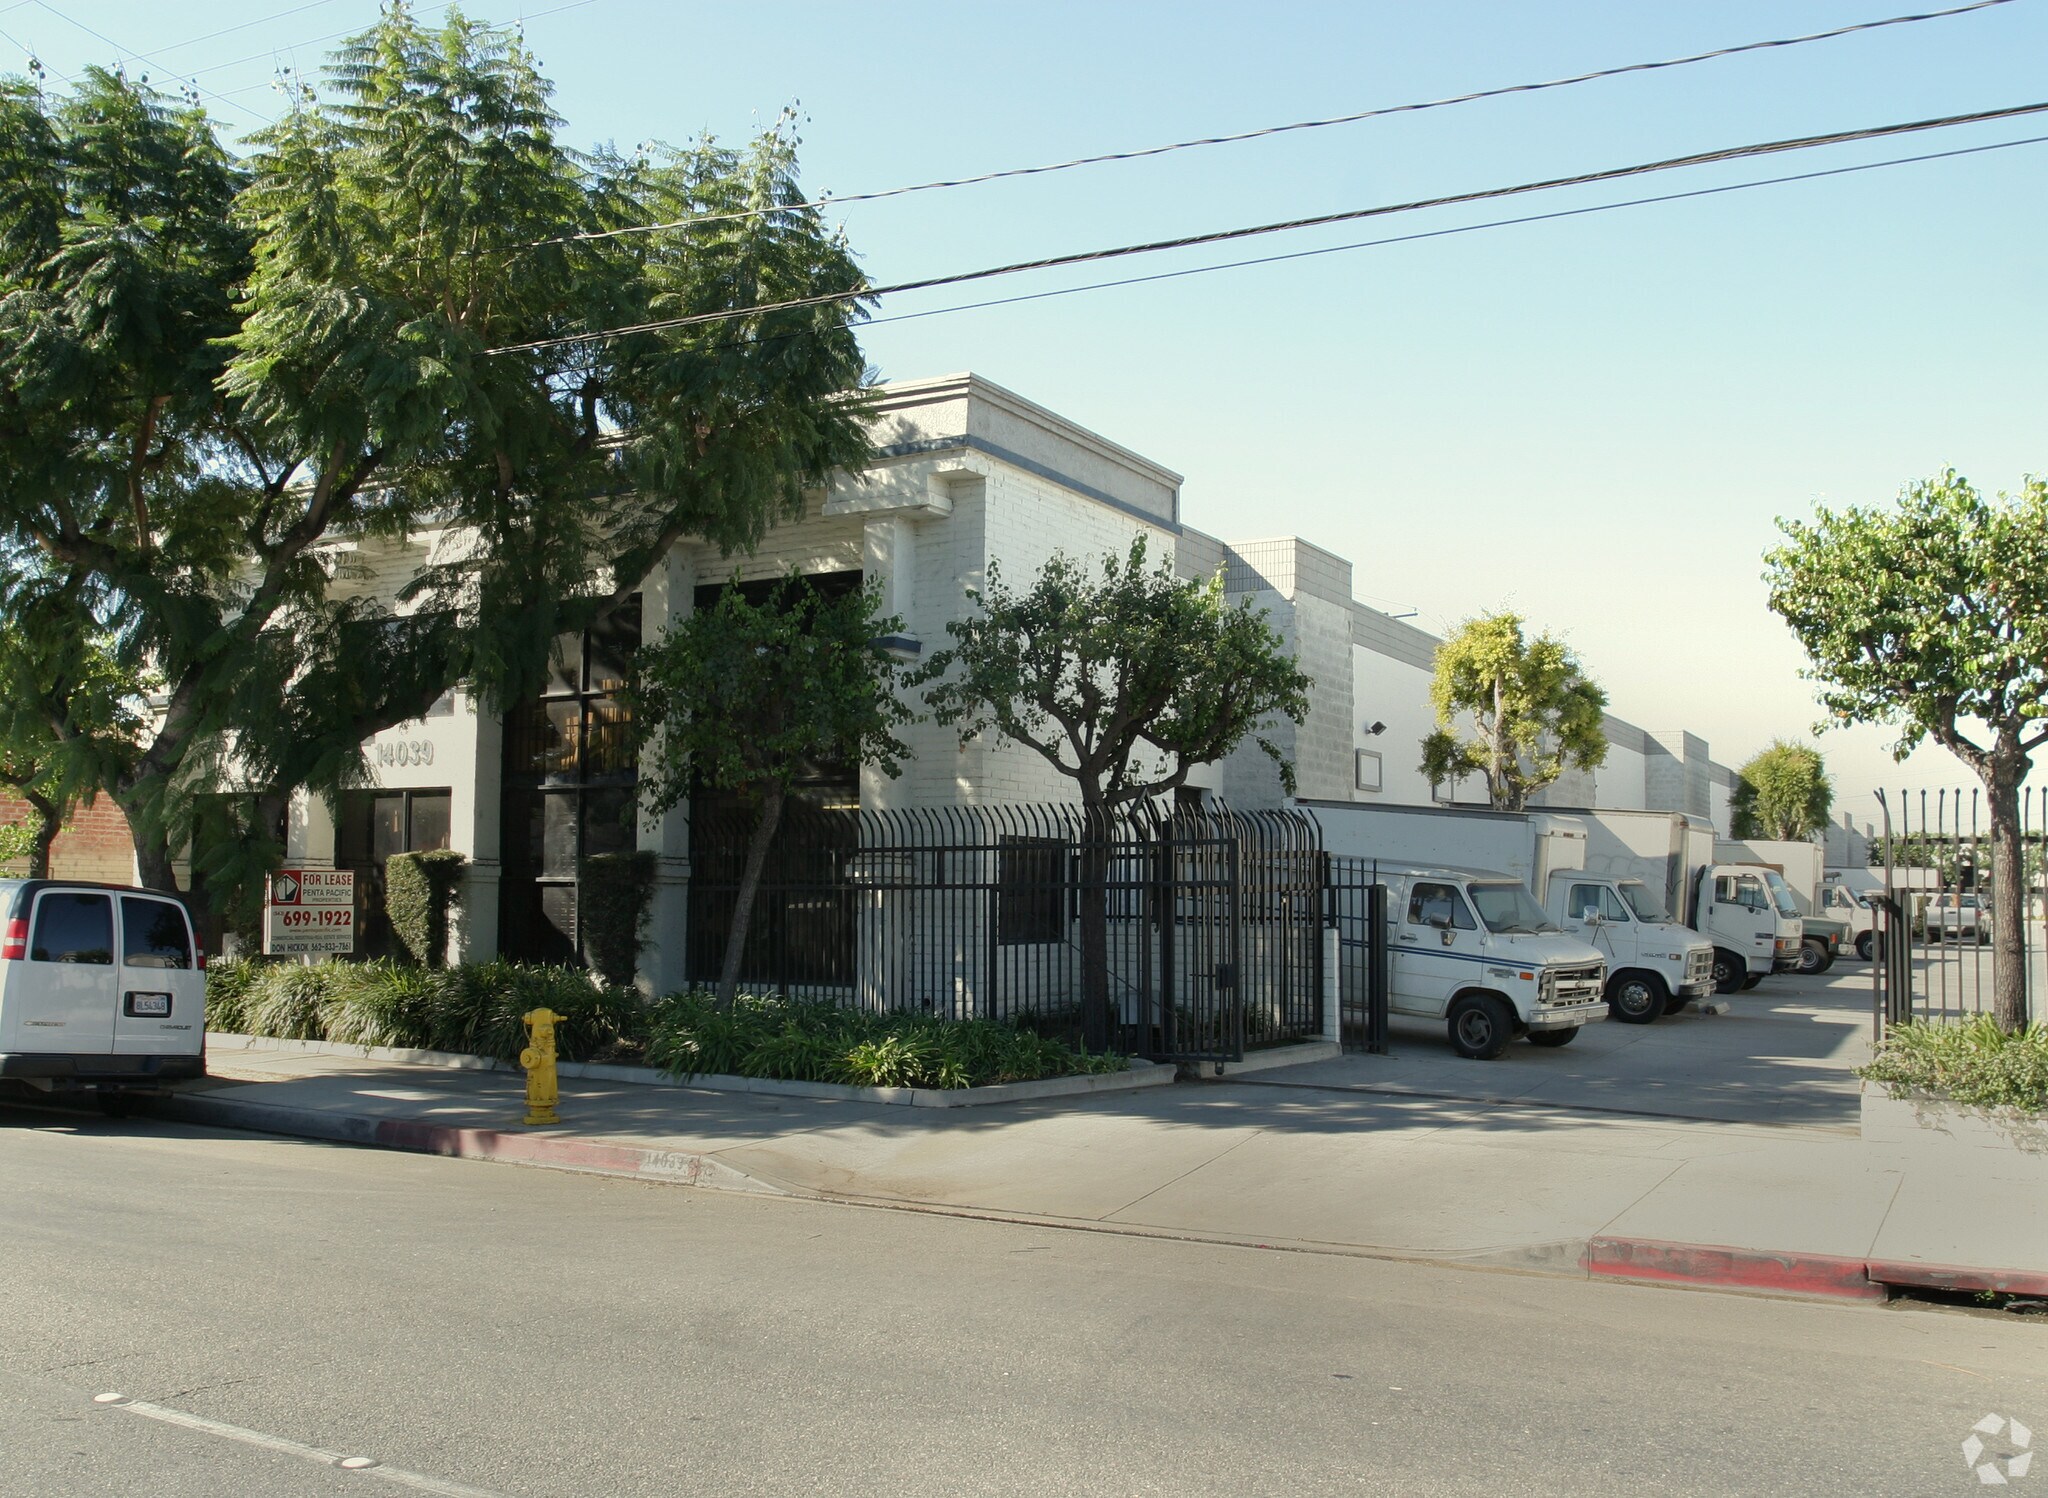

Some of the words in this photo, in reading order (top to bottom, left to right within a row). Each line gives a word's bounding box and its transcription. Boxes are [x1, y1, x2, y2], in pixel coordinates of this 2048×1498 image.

[375, 740, 434, 767] 14039
[303, 874, 321, 885] FOR
[324, 874, 352, 885] LEASE
[303, 889, 325, 897] PENTA
[326, 888, 352, 896] PACIFIC
[283, 910, 351, 926] 699-1922
[271, 944, 286, 952] DON
[287, 943, 309, 952] HICKOK
